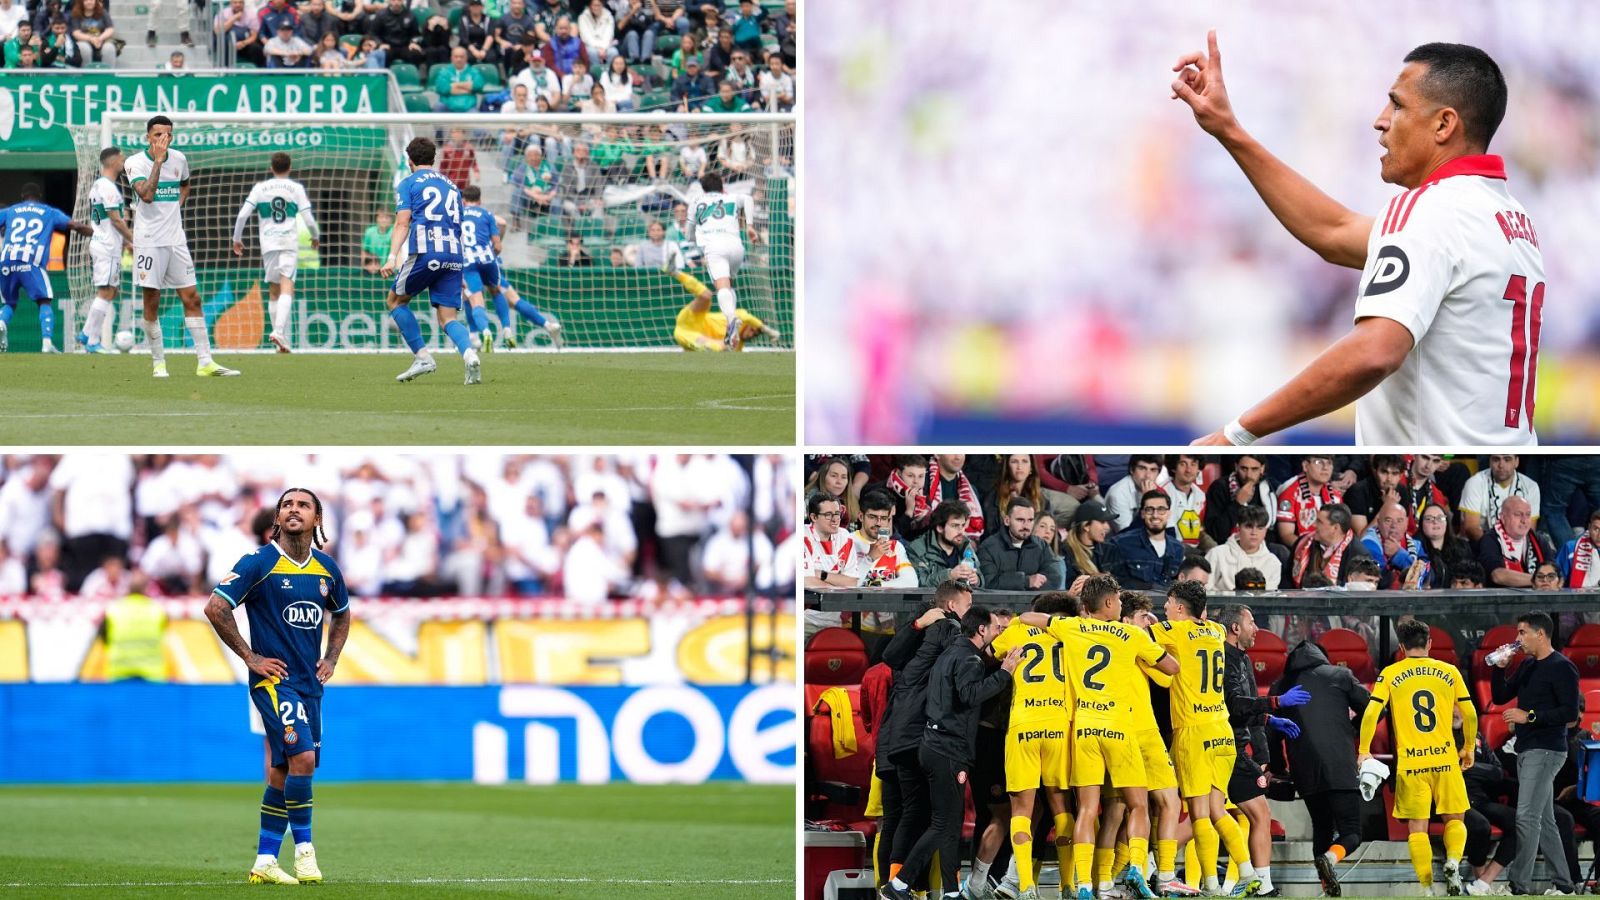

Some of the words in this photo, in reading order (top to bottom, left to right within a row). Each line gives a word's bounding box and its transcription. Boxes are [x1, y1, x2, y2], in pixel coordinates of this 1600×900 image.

[18, 84, 179, 129] ESTEBAN
[206, 83, 373, 128] CABRERA
[75, 131, 148, 146] CETRO
[172, 130, 322, 146] DONTOLÓGICO
[271, 196, 287, 224] 8
[422, 186, 459, 223] 24
[696, 199, 725, 226] 23
[11, 217, 43, 244] 22
[461, 220, 477, 246] 8
[137, 254, 153, 271] 20
[1574, 541, 1593, 571] RAYO
[1083, 644, 1111, 691] 2
[1196, 650, 1224, 694] 16
[1392, 668, 1414, 688] FRAN
[1416, 666, 1455, 688] BELTRÁN
[279, 701, 309, 726] 24
[1412, 689, 1437, 733] 8
[473, 684, 796, 784] moe
[1025, 729, 1064, 742] parlem
[1084, 728, 1125, 741] parlem
